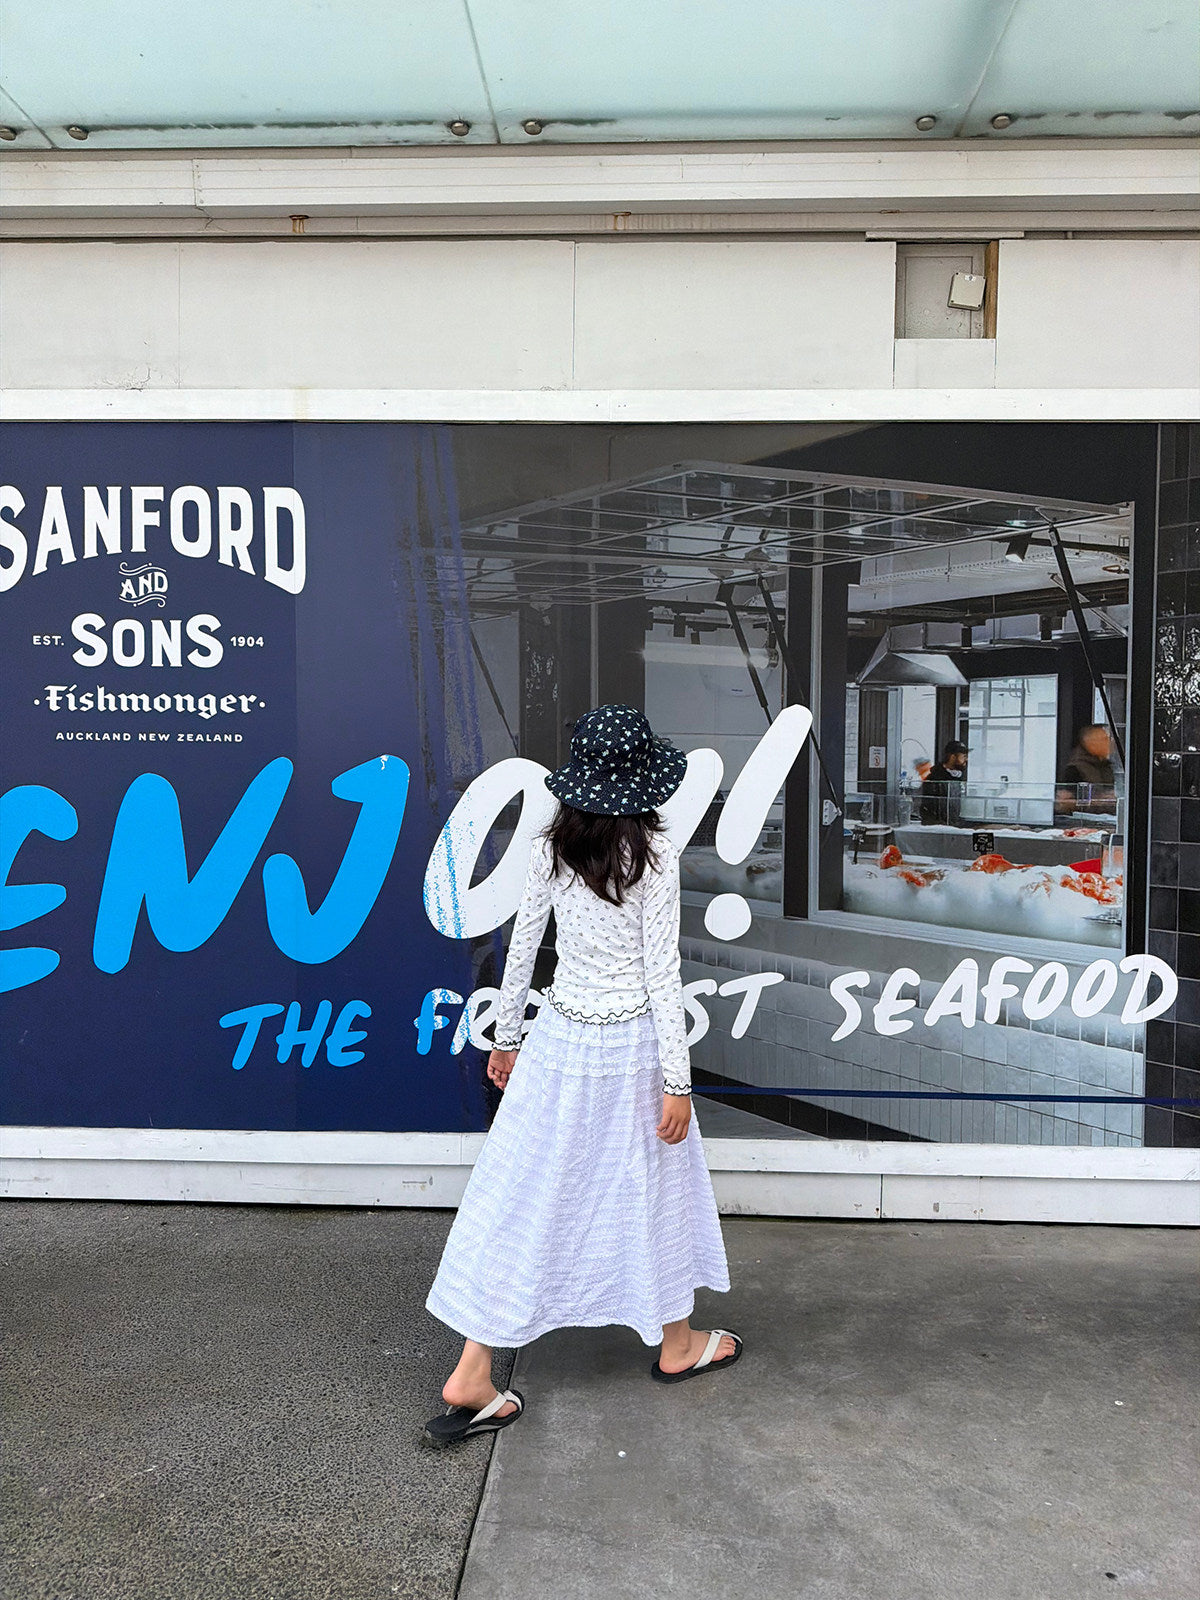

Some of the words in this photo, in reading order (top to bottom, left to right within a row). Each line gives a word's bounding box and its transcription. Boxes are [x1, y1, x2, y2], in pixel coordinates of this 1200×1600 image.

[0, 485, 307, 595] SANFORD
[119, 571, 168, 598] AND
[32, 635, 65, 646] EST.
[71, 612, 224, 668] SONS
[230, 636, 264, 647] 1904
[55, 732, 131, 742] AUCKLAND
[138, 733, 170, 743] NEW
[177, 733, 243, 743] ZEALAND
[219, 1000, 372, 1070] THE
[829, 953, 1179, 1042] SEAFOOD
